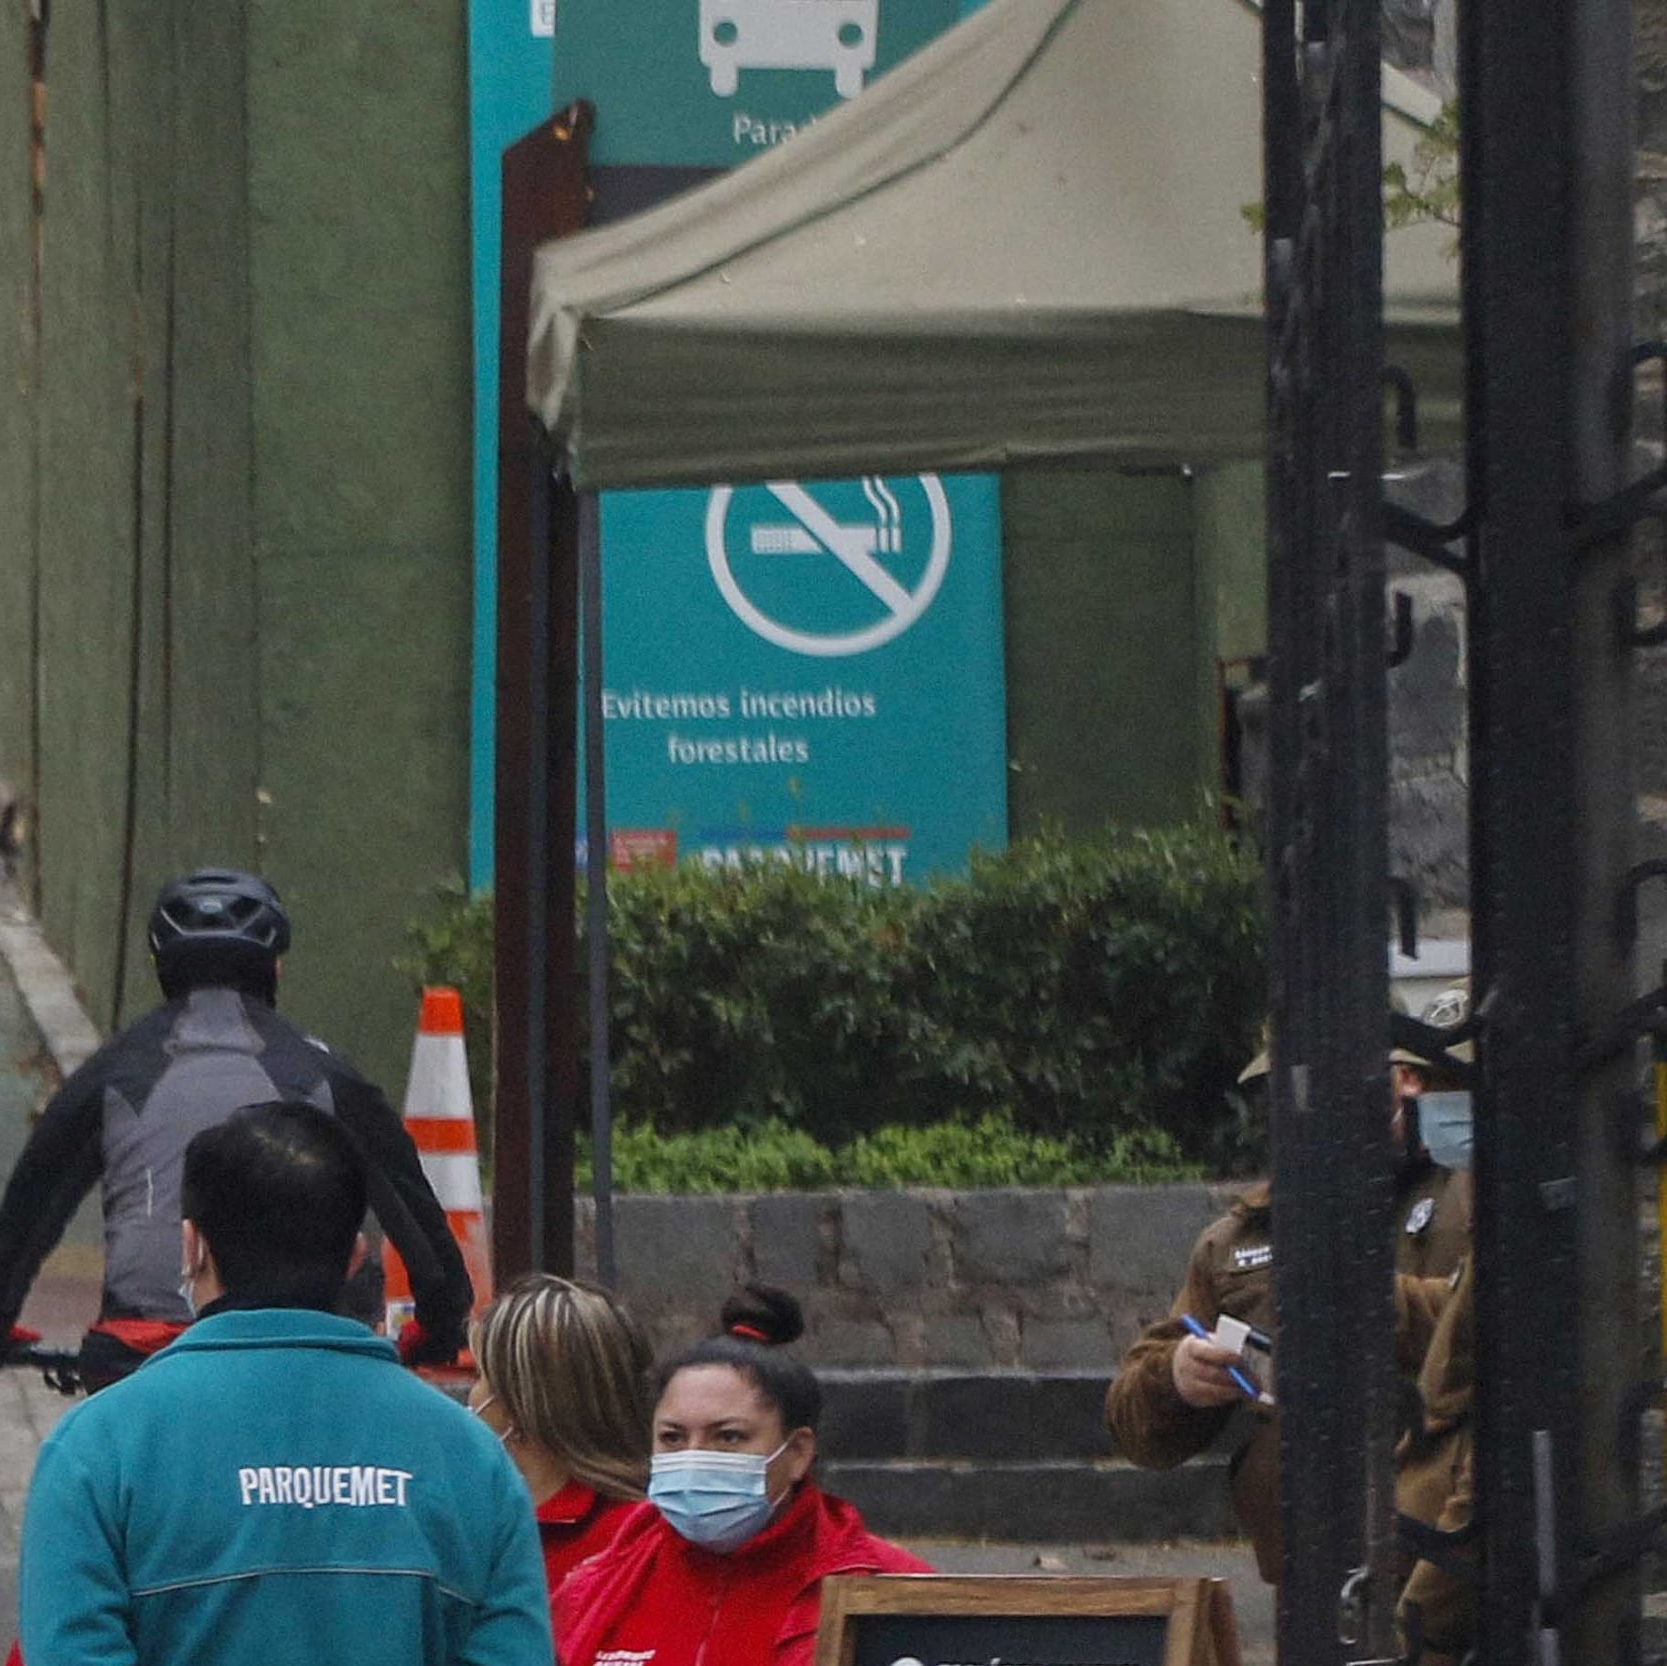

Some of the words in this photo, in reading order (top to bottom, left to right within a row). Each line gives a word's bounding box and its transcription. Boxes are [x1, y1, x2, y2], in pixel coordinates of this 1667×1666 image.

[733, 113, 817, 145] Para
[602, 687, 730, 719] Evitemos
[740, 685, 876, 717] incendios
[668, 730, 809, 763] forestales
[239, 1466, 413, 1508] PARQUEMET
